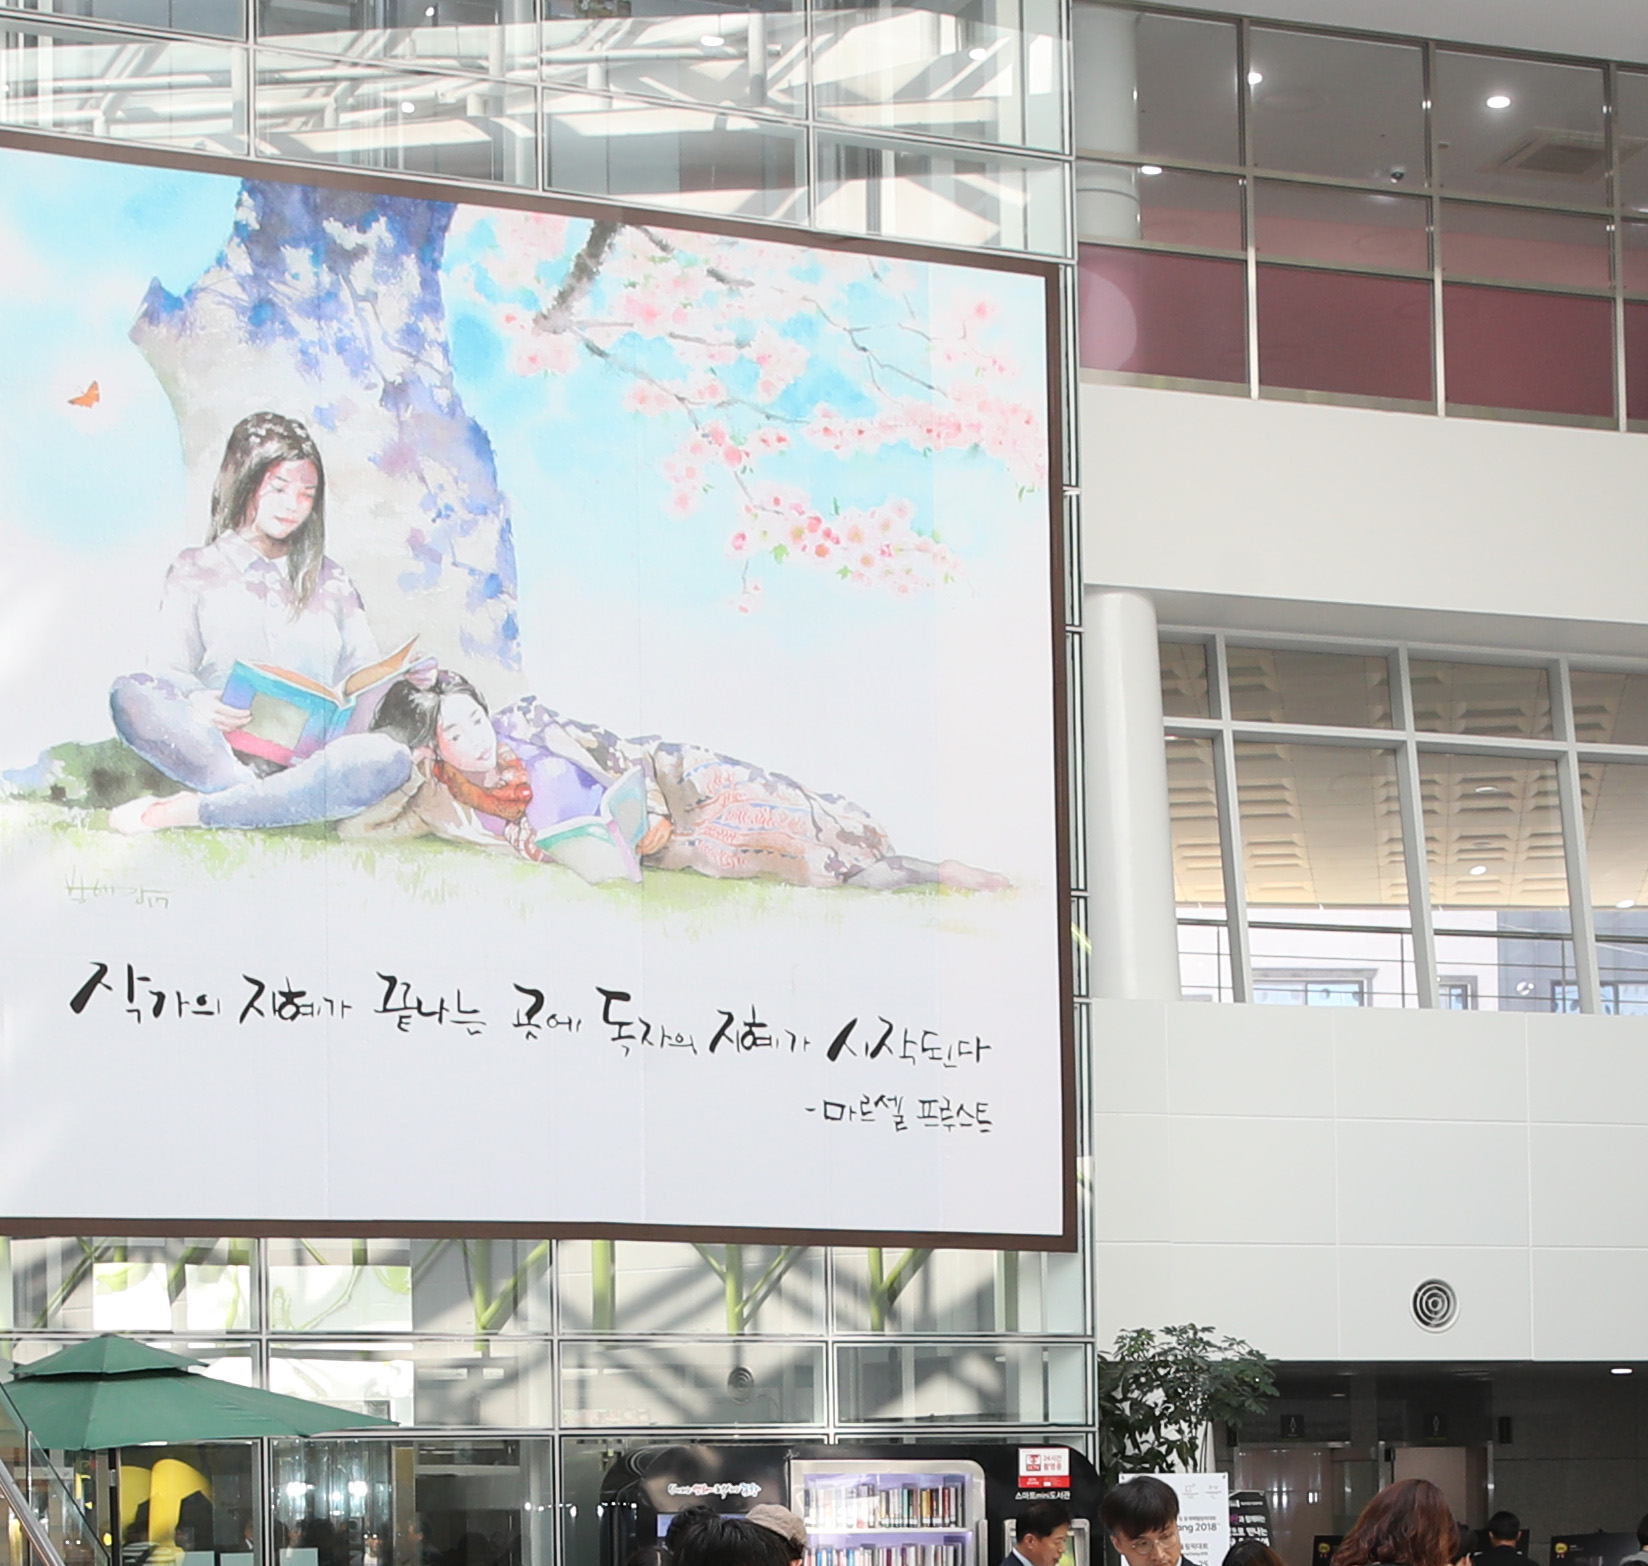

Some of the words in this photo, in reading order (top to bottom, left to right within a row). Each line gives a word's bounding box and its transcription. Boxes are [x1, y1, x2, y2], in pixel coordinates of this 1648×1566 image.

[69, 961, 221, 1024] 작가의
[239, 973, 352, 1024] 지혜가
[373, 971, 487, 1035] 끝나는
[595, 986, 697, 1059] 독자의
[709, 1003, 811, 1055] 지혜가
[826, 1015, 992, 1069] 시작된다
[916, 1095, 993, 1135] 프루스트
